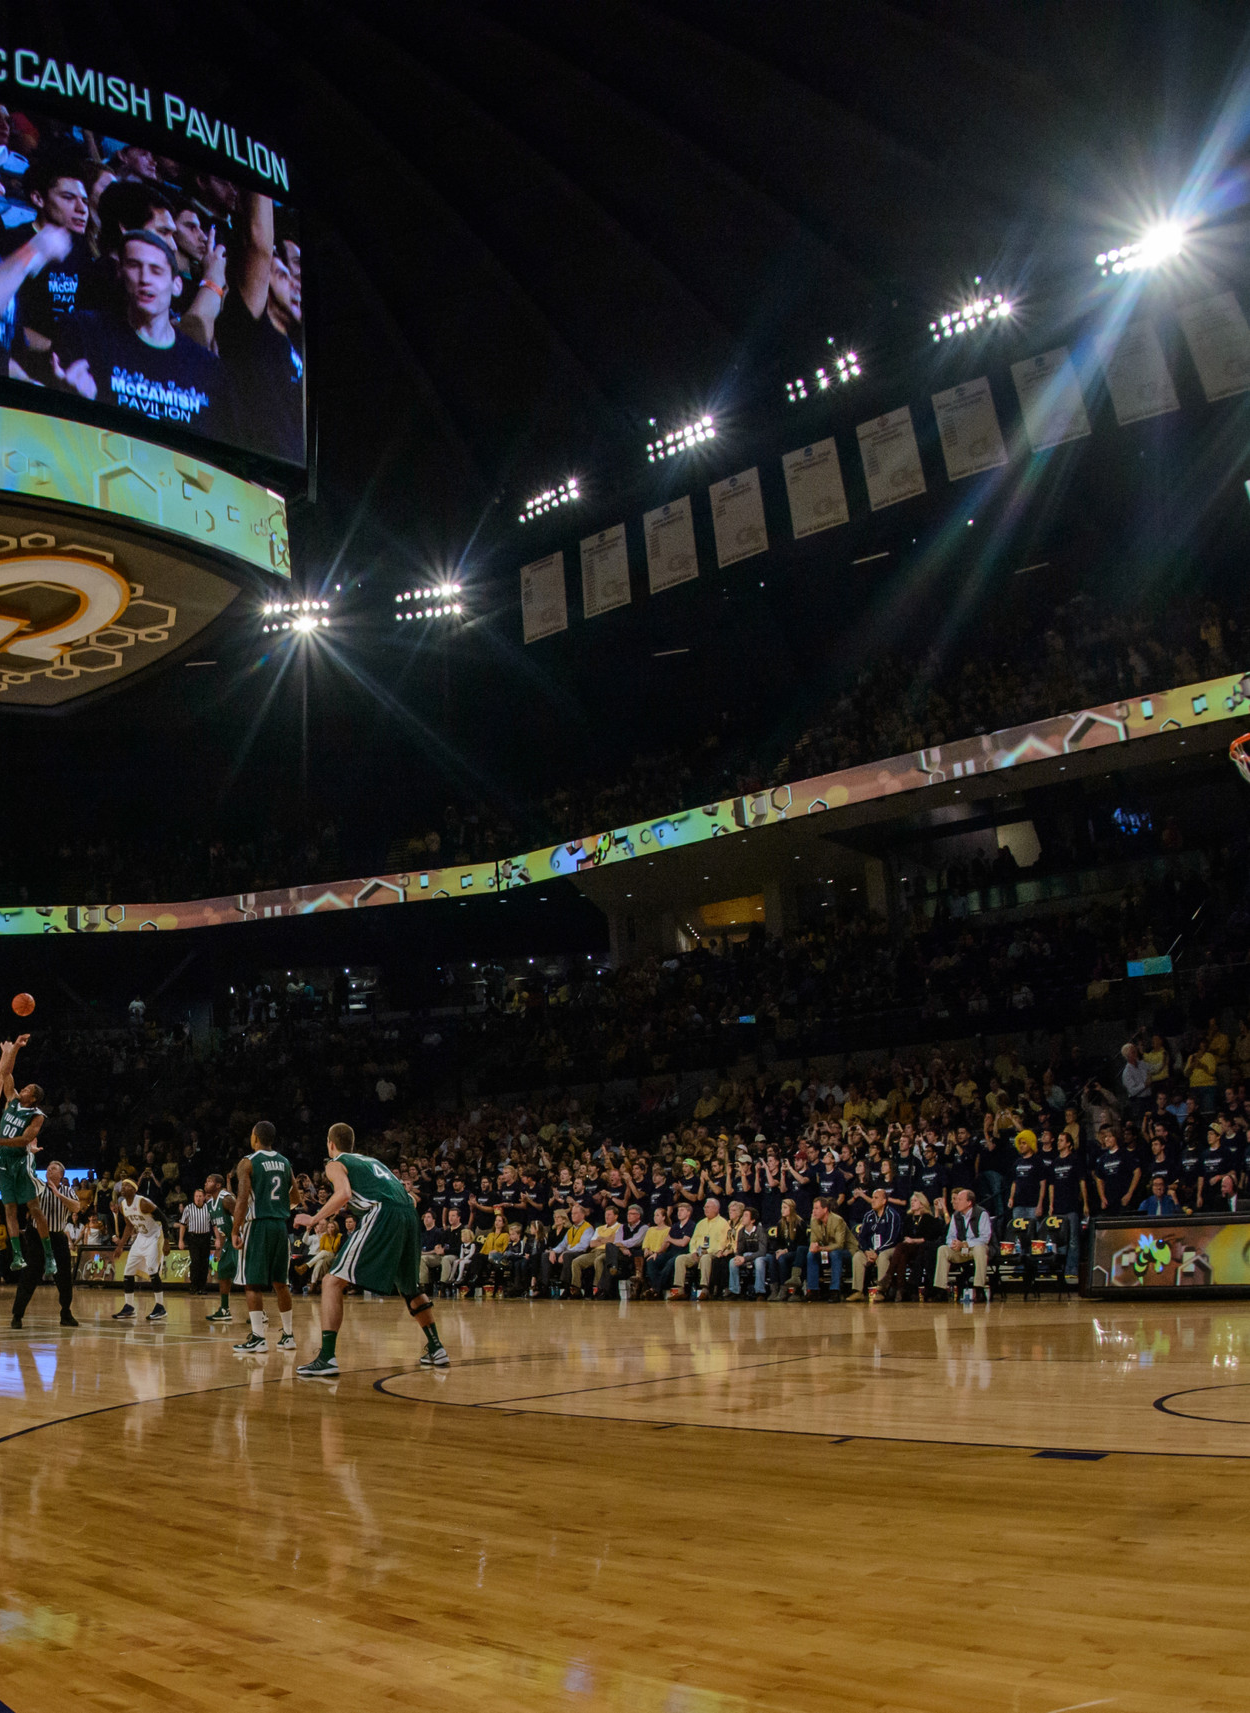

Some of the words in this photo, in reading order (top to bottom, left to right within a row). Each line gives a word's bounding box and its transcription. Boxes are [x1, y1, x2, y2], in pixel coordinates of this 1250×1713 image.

[164, 91, 291, 192] PAVILION
[118, 394, 191, 423] PAVILION
[2, 1124, 18, 1139] 00
[373, 1164, 392, 1181] 4
[270, 1175, 282, 1201] 2
